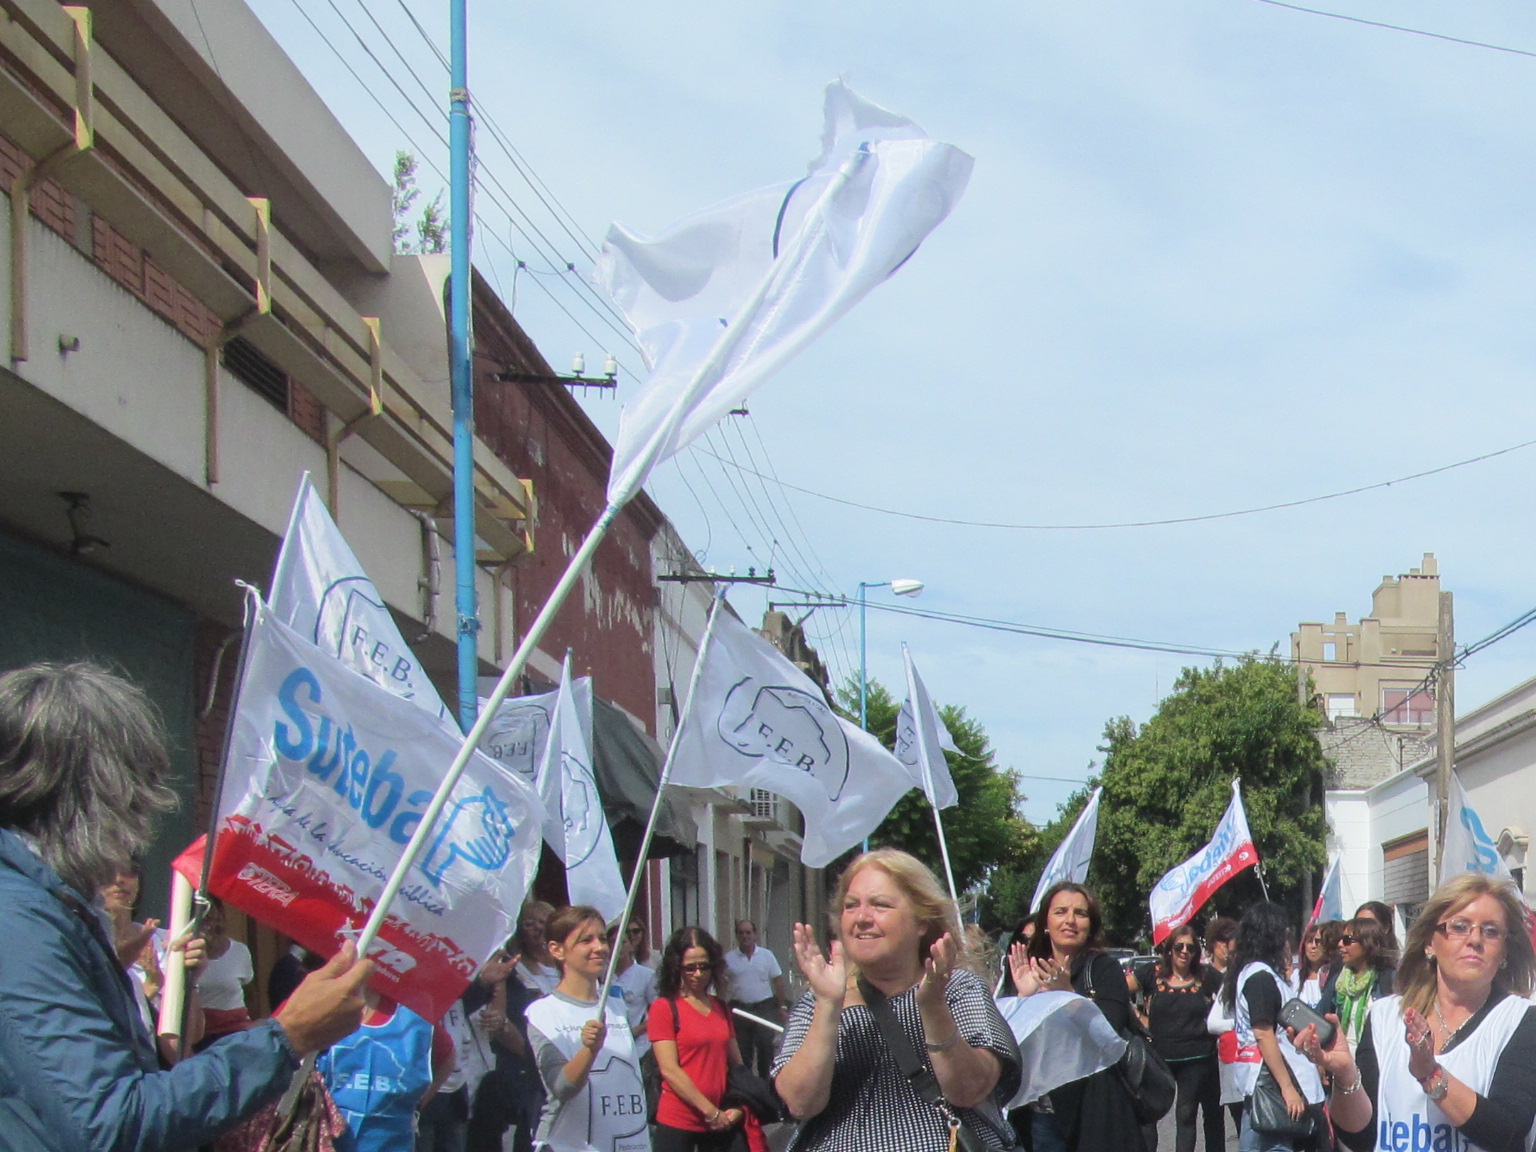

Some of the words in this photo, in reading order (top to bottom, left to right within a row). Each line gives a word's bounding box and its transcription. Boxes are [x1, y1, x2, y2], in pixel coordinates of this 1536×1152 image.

[353, 624, 415, 688] F.E.B.
[275, 667, 437, 844] Suteba
[758, 721, 815, 776] F.E.B.
[400, 884, 444, 916] ública
